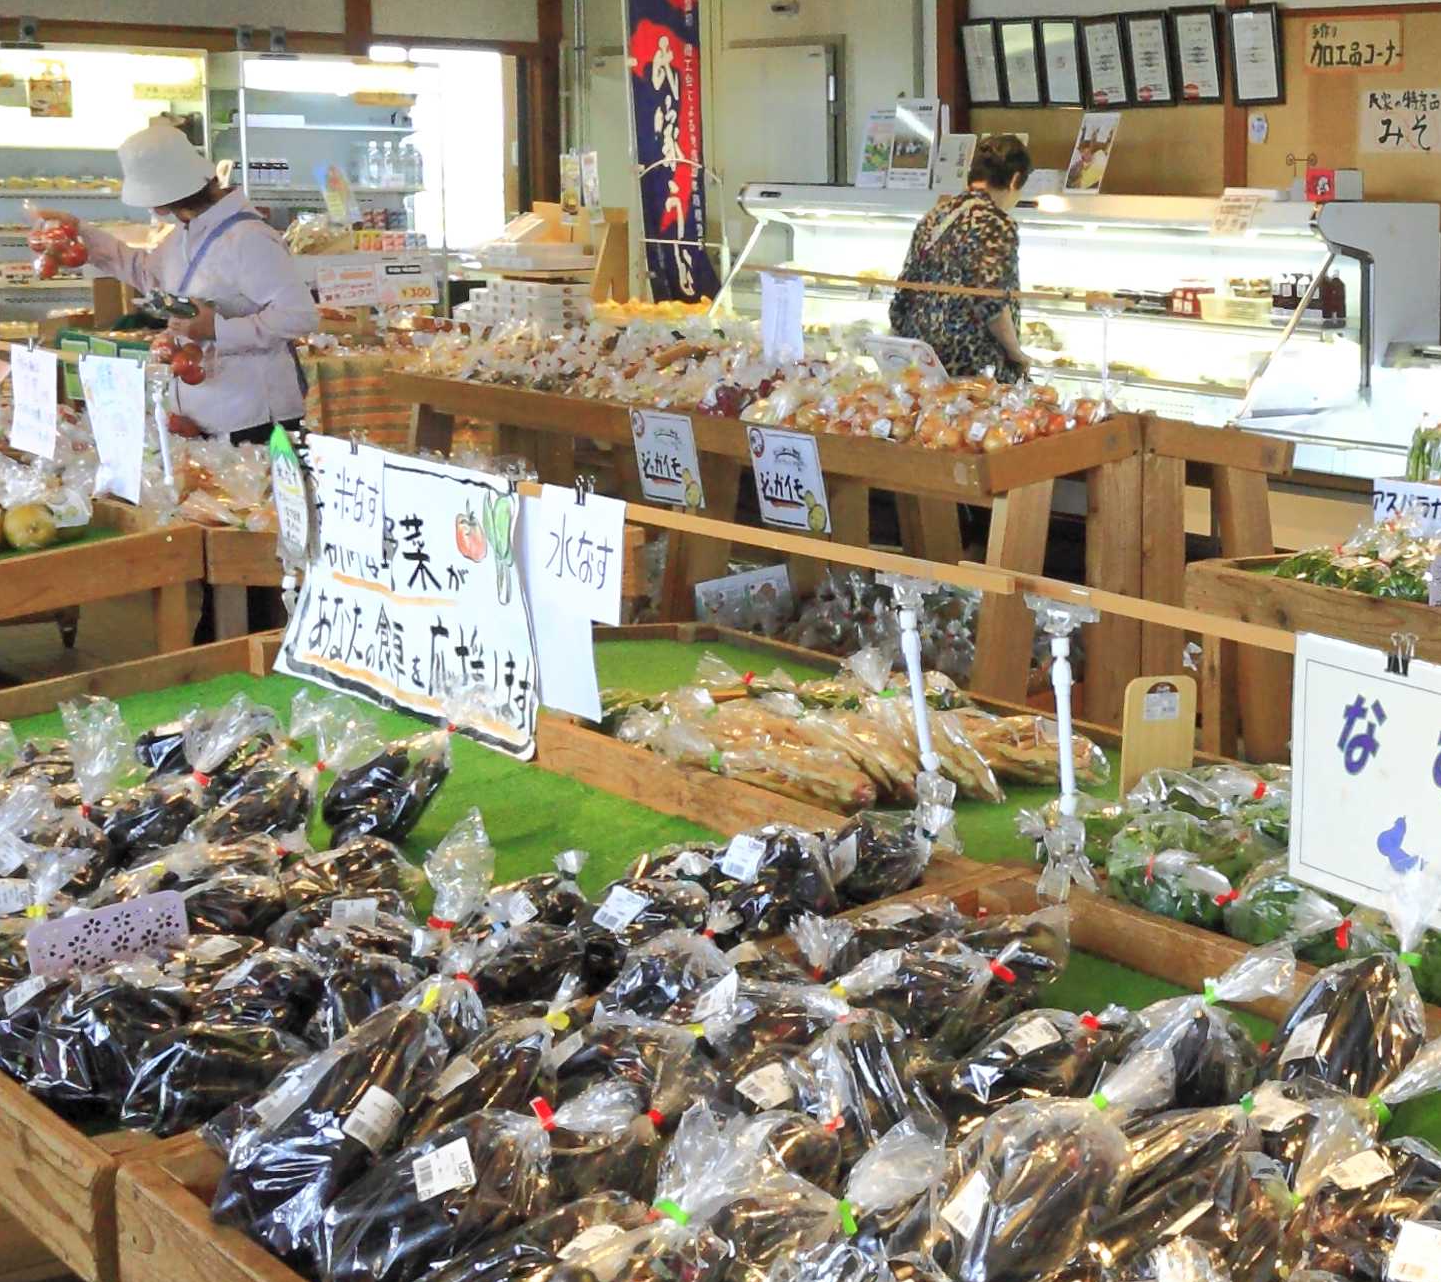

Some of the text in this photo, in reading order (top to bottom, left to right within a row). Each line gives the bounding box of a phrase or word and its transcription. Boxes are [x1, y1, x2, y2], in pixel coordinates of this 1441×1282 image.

[1311, 22, 1337, 39] 手作り
[1310, 39, 1403, 68] 加工品コーナー
[1378, 115, 1431, 151] みそ
[547, 529, 616, 591] 水なす
